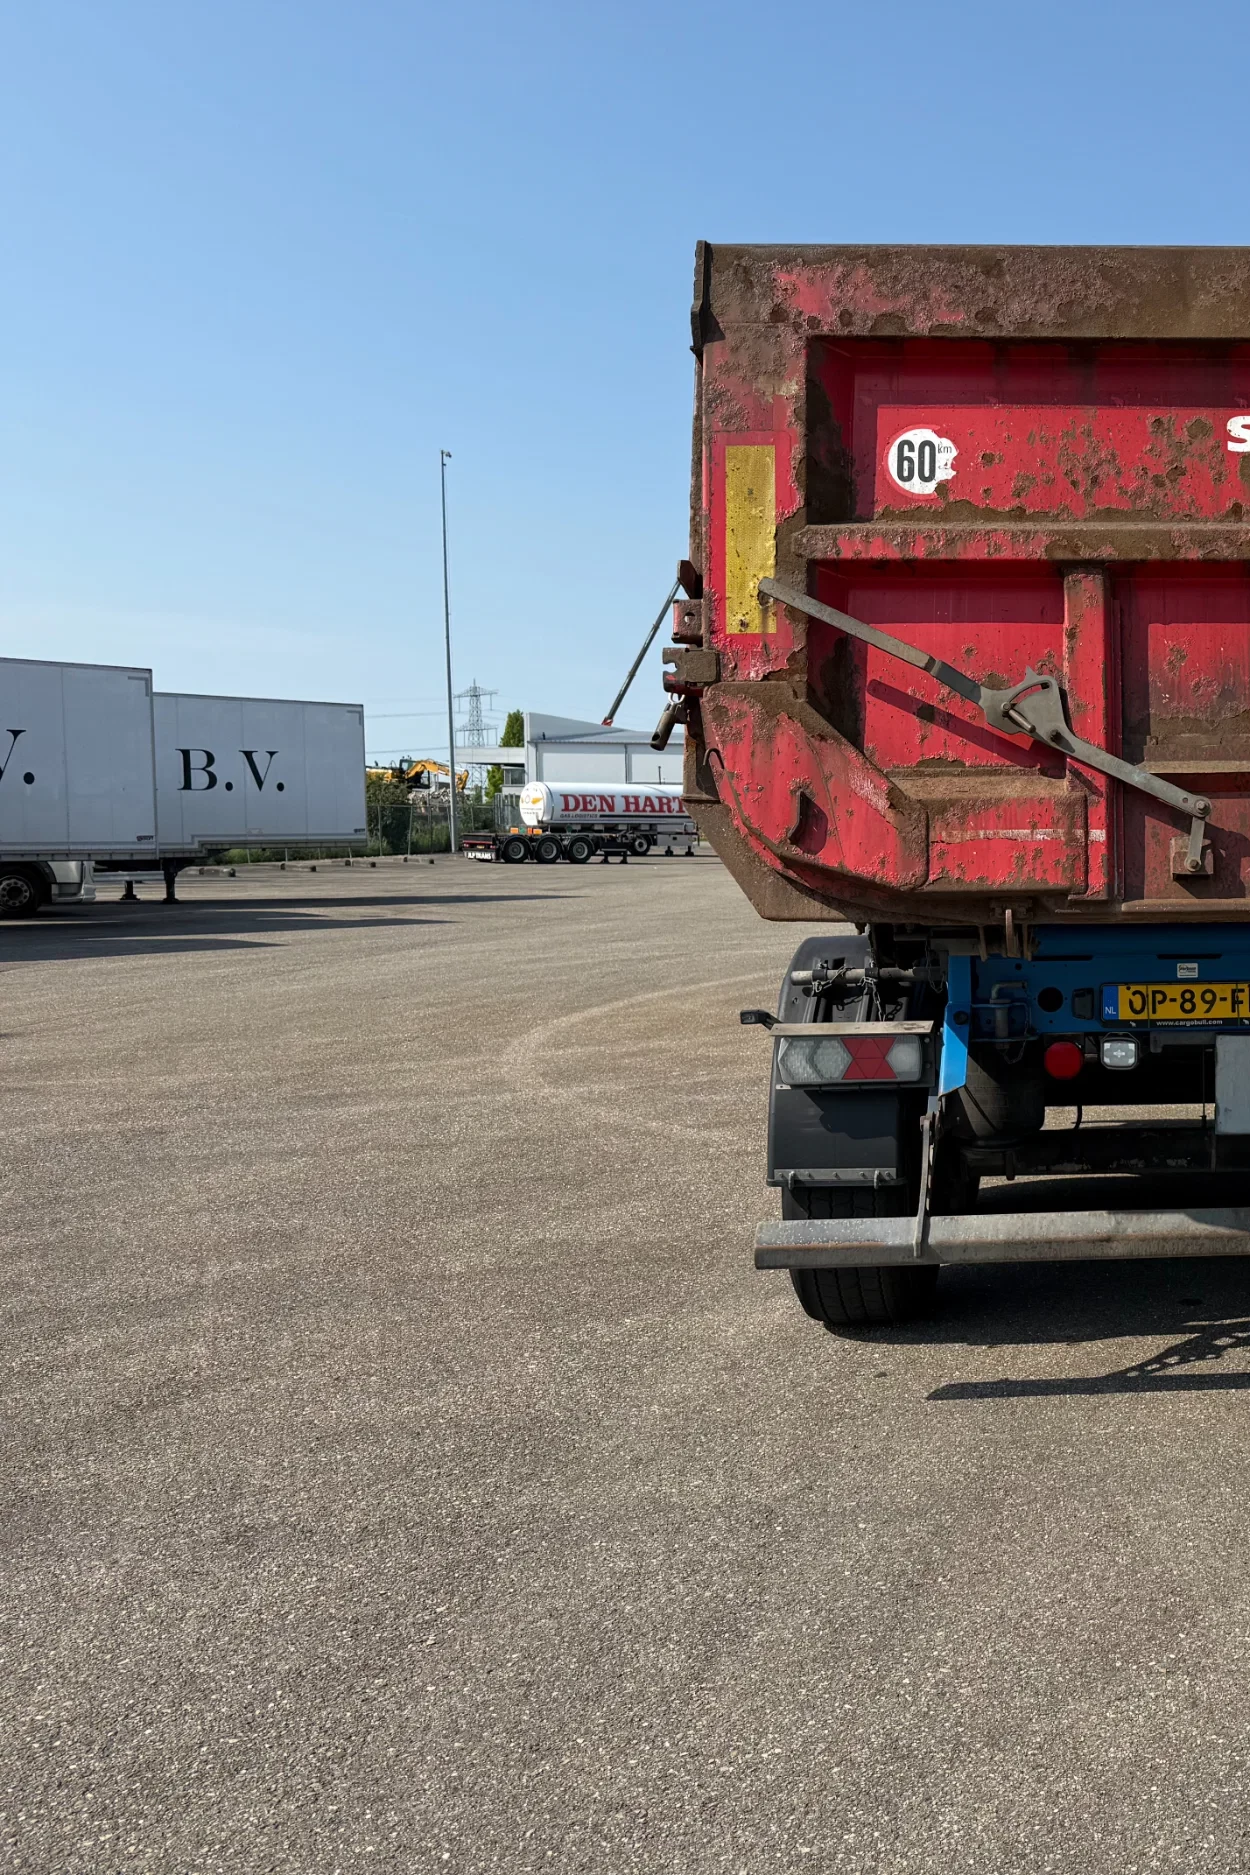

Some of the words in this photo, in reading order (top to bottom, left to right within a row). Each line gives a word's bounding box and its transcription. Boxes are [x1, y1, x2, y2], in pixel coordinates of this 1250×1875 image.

[896, 439, 936, 482] 60
[938, 443, 953, 454] km
[175, 748, 285, 792] B.V.
[559, 794, 615, 813] DEN
[1104, 1006, 1117, 1015] NL
[1156, 1019, 1223, 1027] www.cargobull.com
